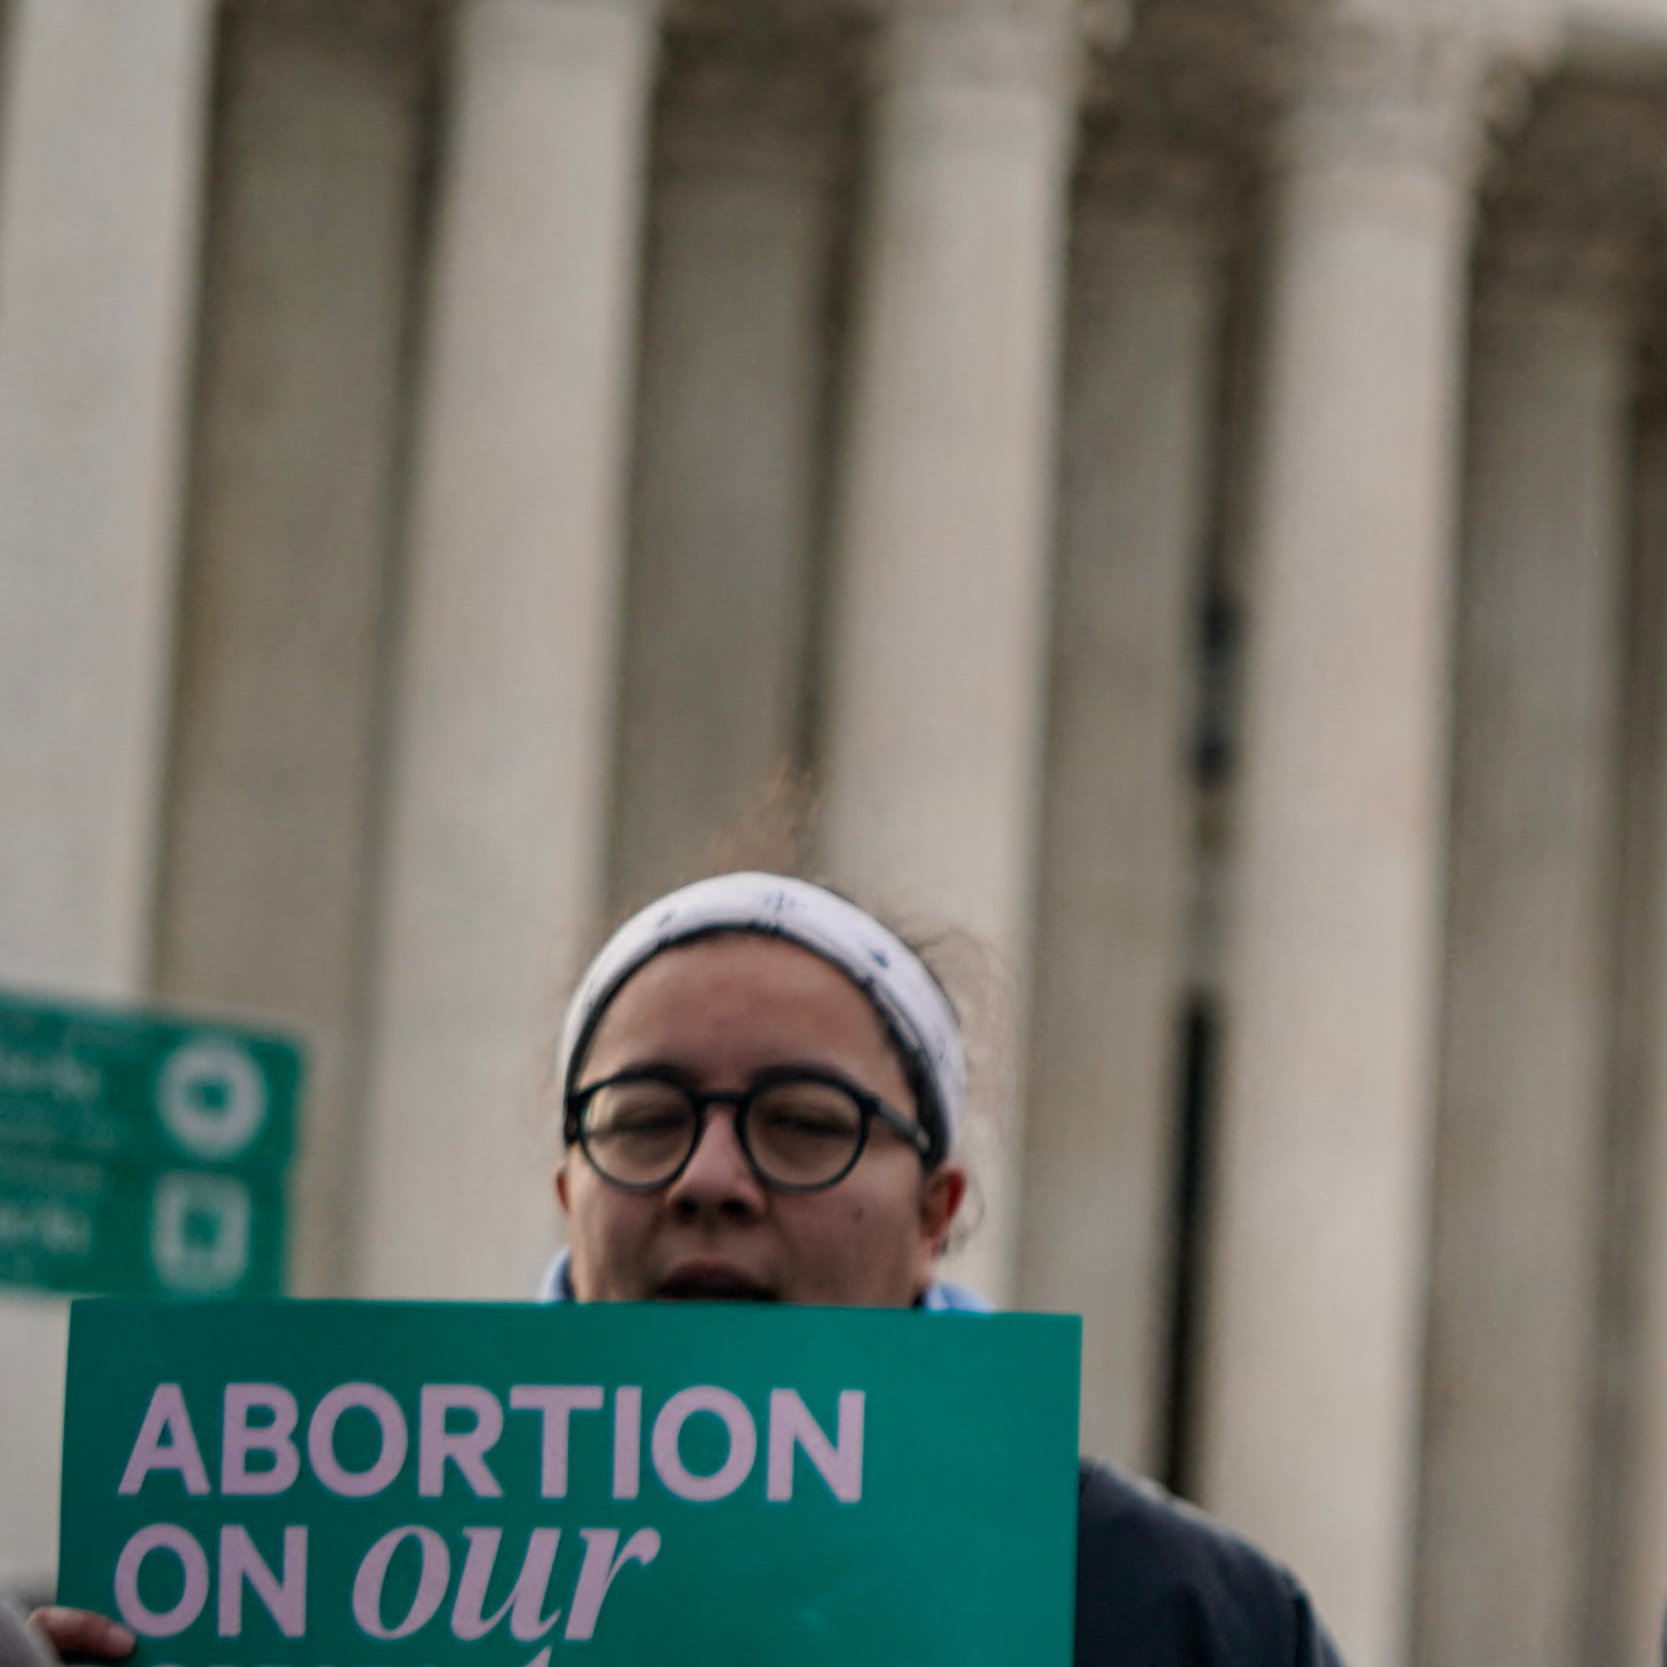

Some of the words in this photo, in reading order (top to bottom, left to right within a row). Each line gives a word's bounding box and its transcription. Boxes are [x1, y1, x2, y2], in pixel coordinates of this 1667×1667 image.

[117, 1381, 866, 1504] ABORTION
[113, 1522, 308, 1638] ON
[352, 1524, 662, 1642] our
